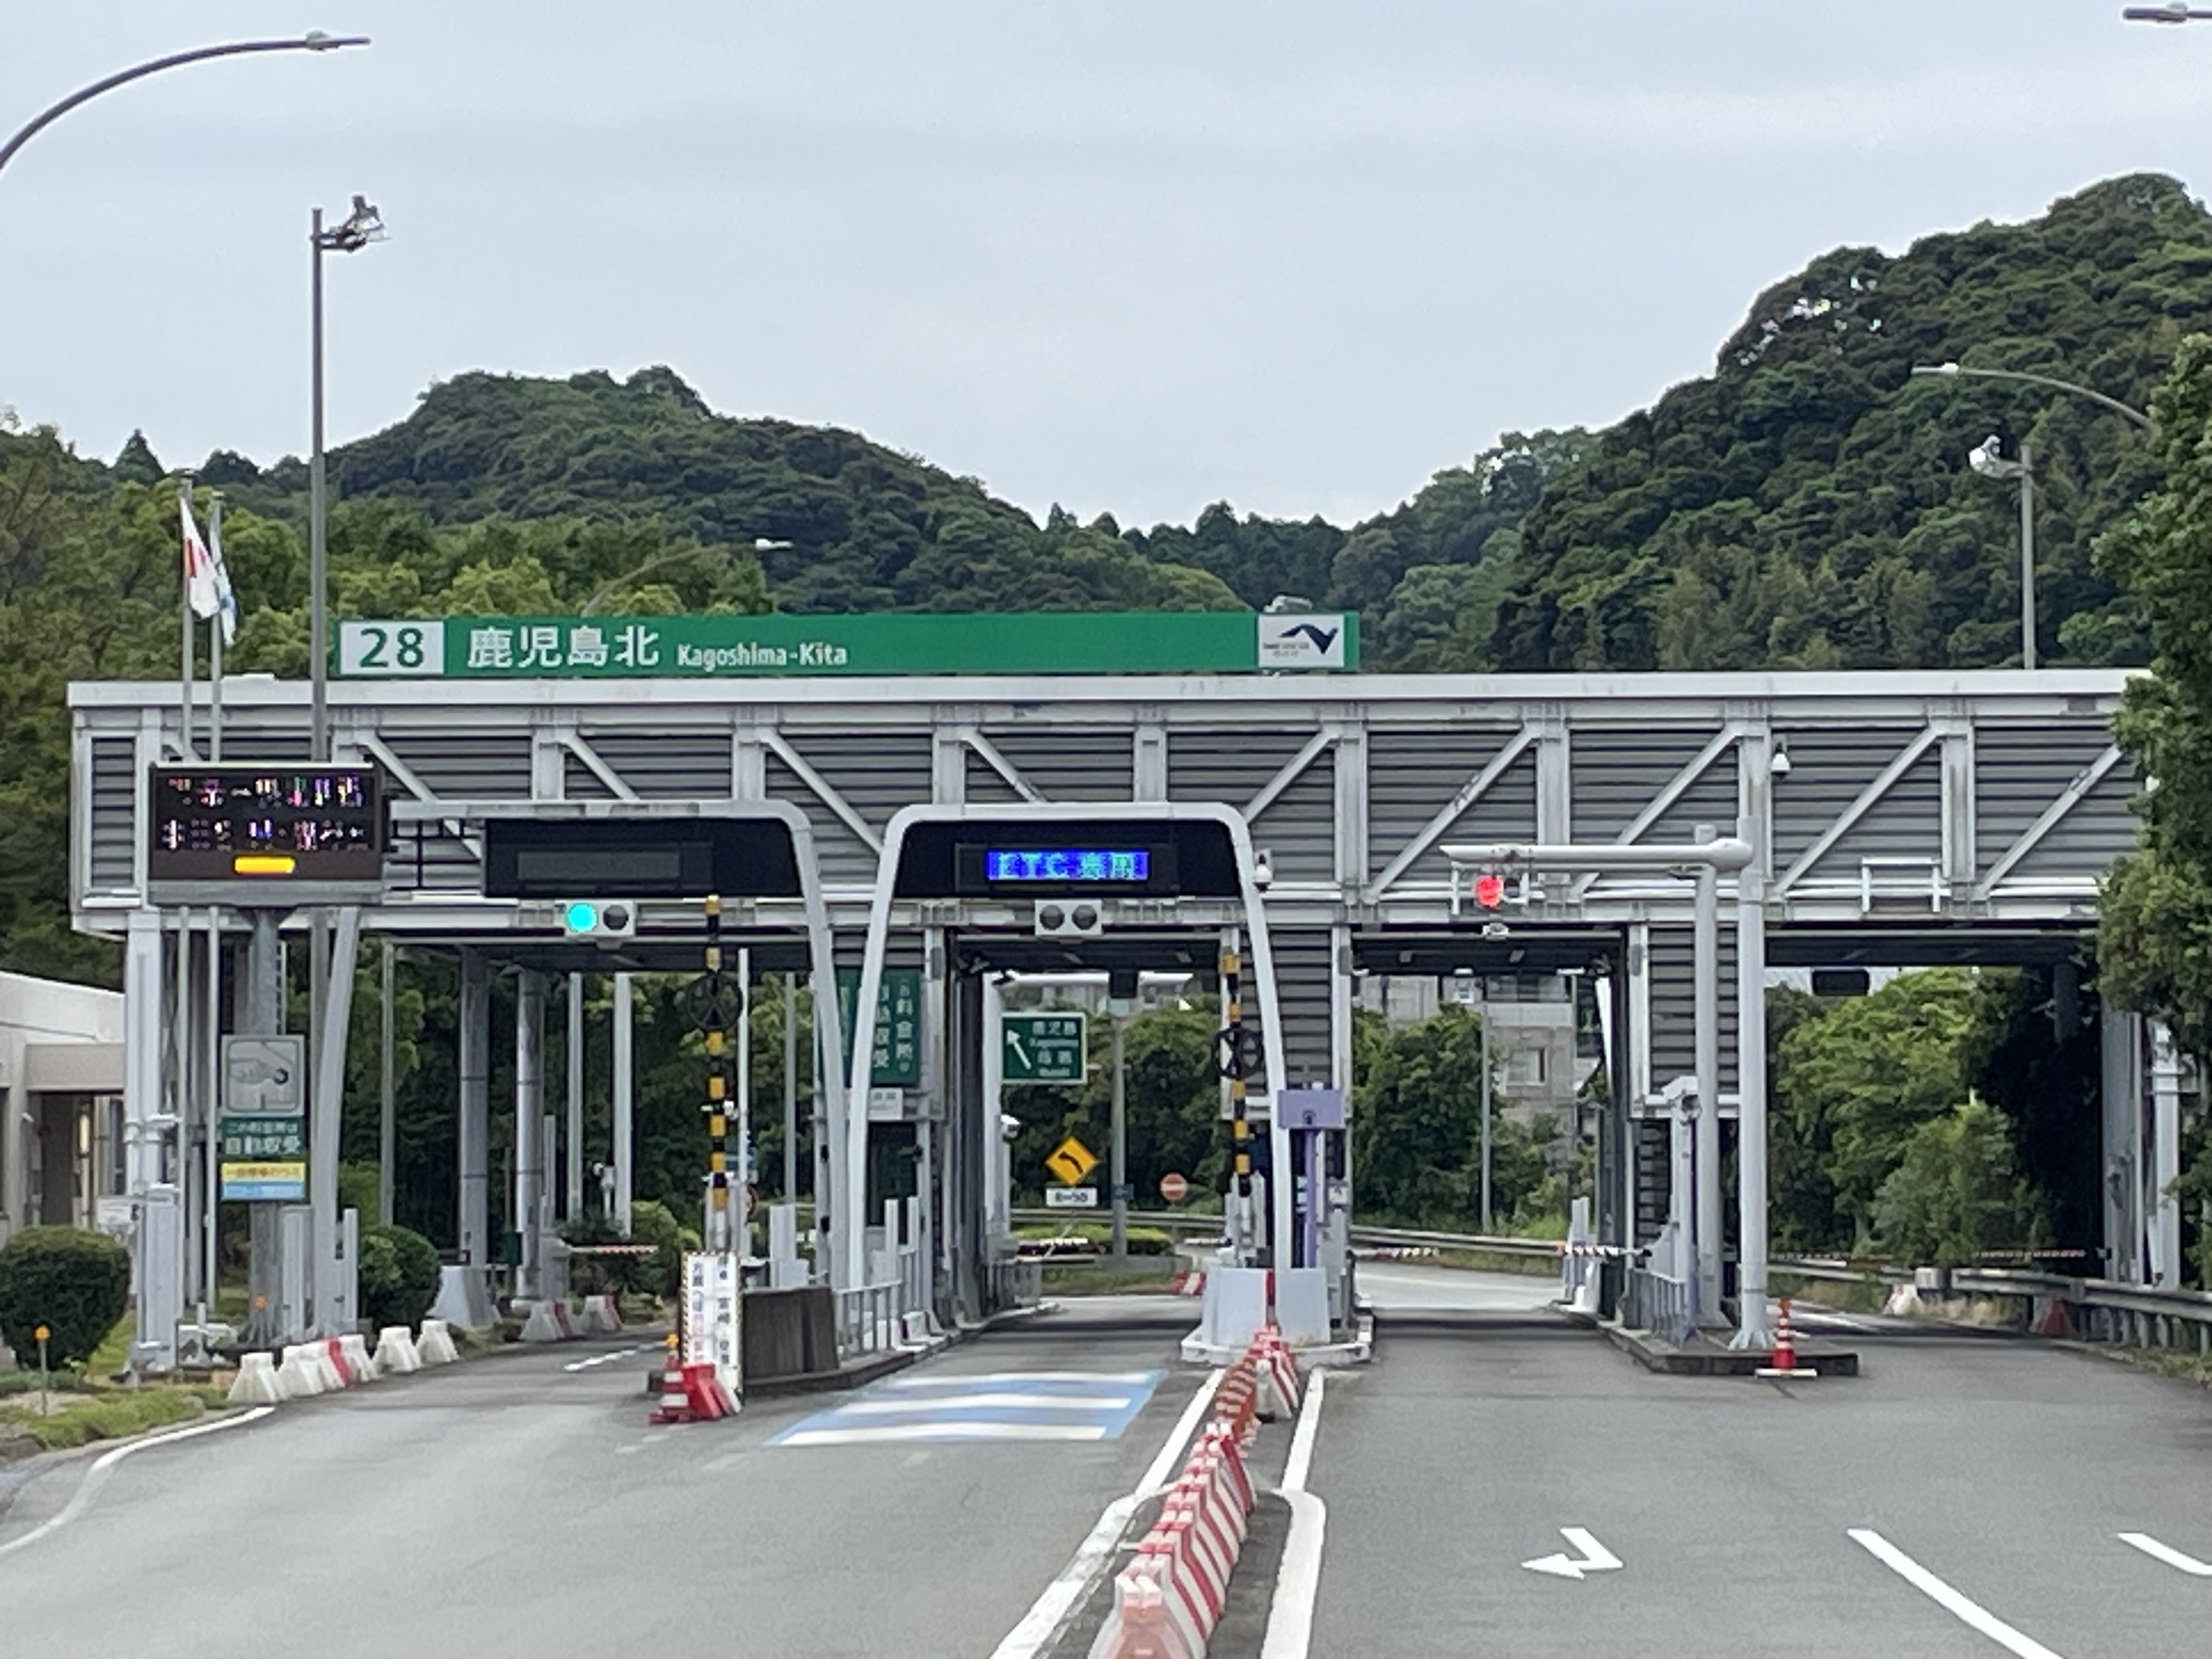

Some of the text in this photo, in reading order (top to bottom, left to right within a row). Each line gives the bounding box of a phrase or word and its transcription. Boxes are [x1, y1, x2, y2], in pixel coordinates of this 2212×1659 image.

[359, 628, 424, 668] 28
[467, 625, 659, 668] 鹿児島北
[678, 641, 848, 672] Kagoshima-Kita
